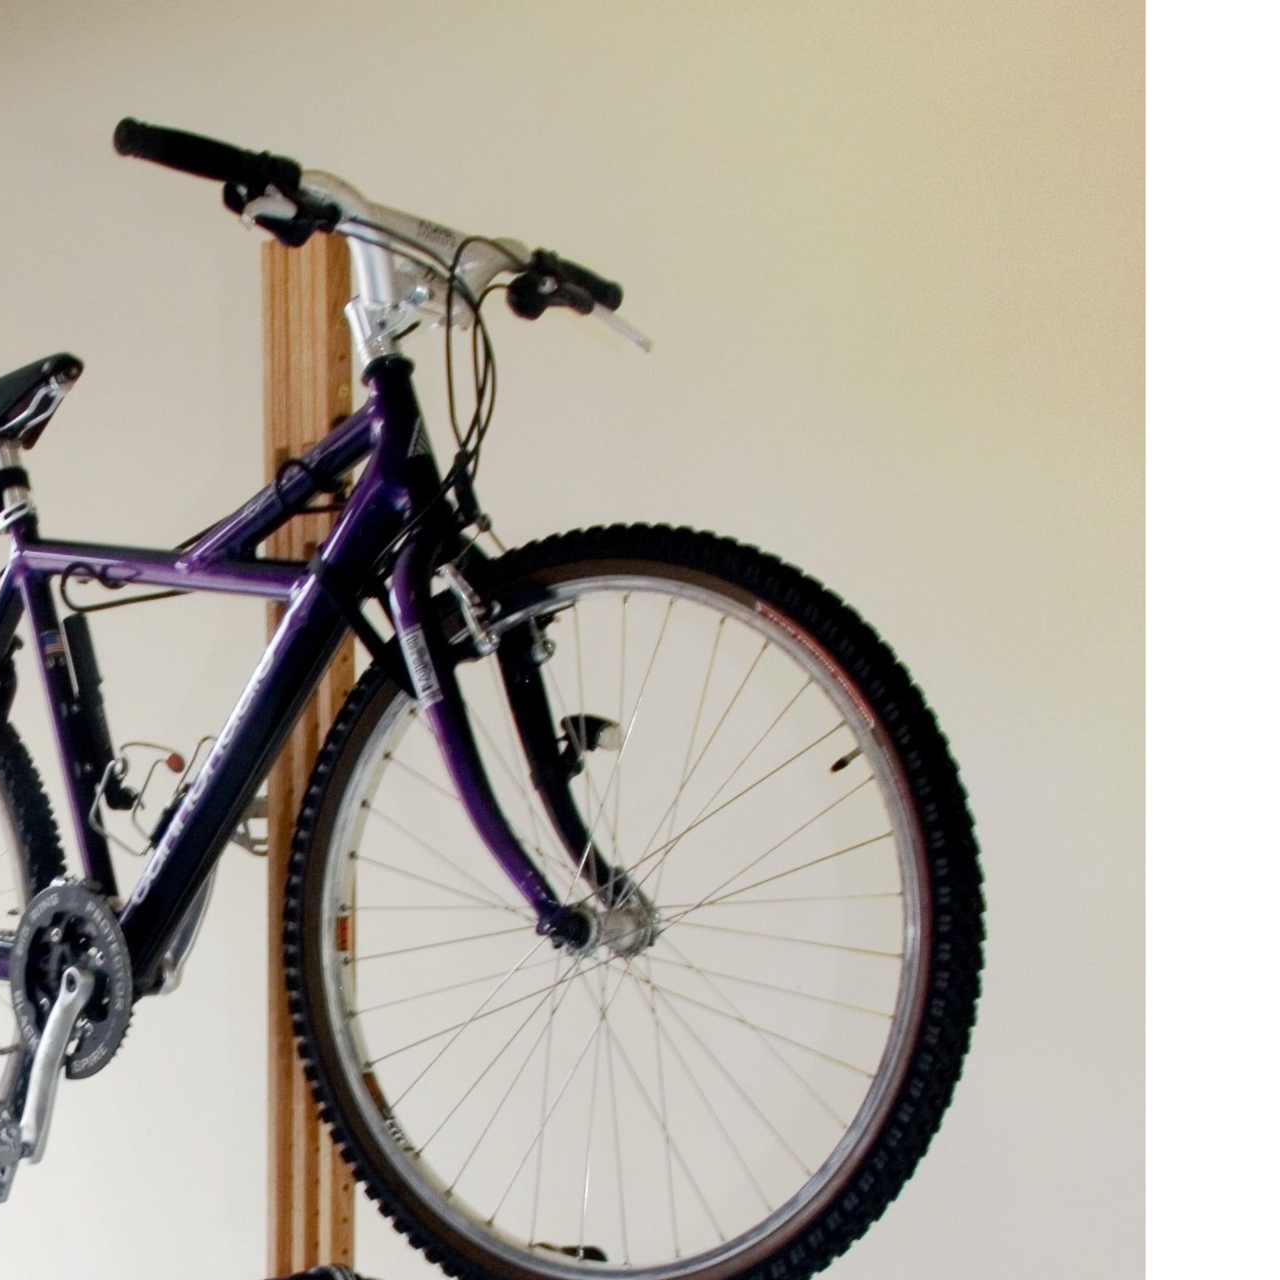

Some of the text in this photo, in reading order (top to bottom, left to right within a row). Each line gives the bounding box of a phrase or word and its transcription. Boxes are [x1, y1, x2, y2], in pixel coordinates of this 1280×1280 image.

[29, 892, 60, 923] RING
[84, 900, 125, 1011] PROTECTOR
[13, 989, 109, 1074] BLACK SPIRE
